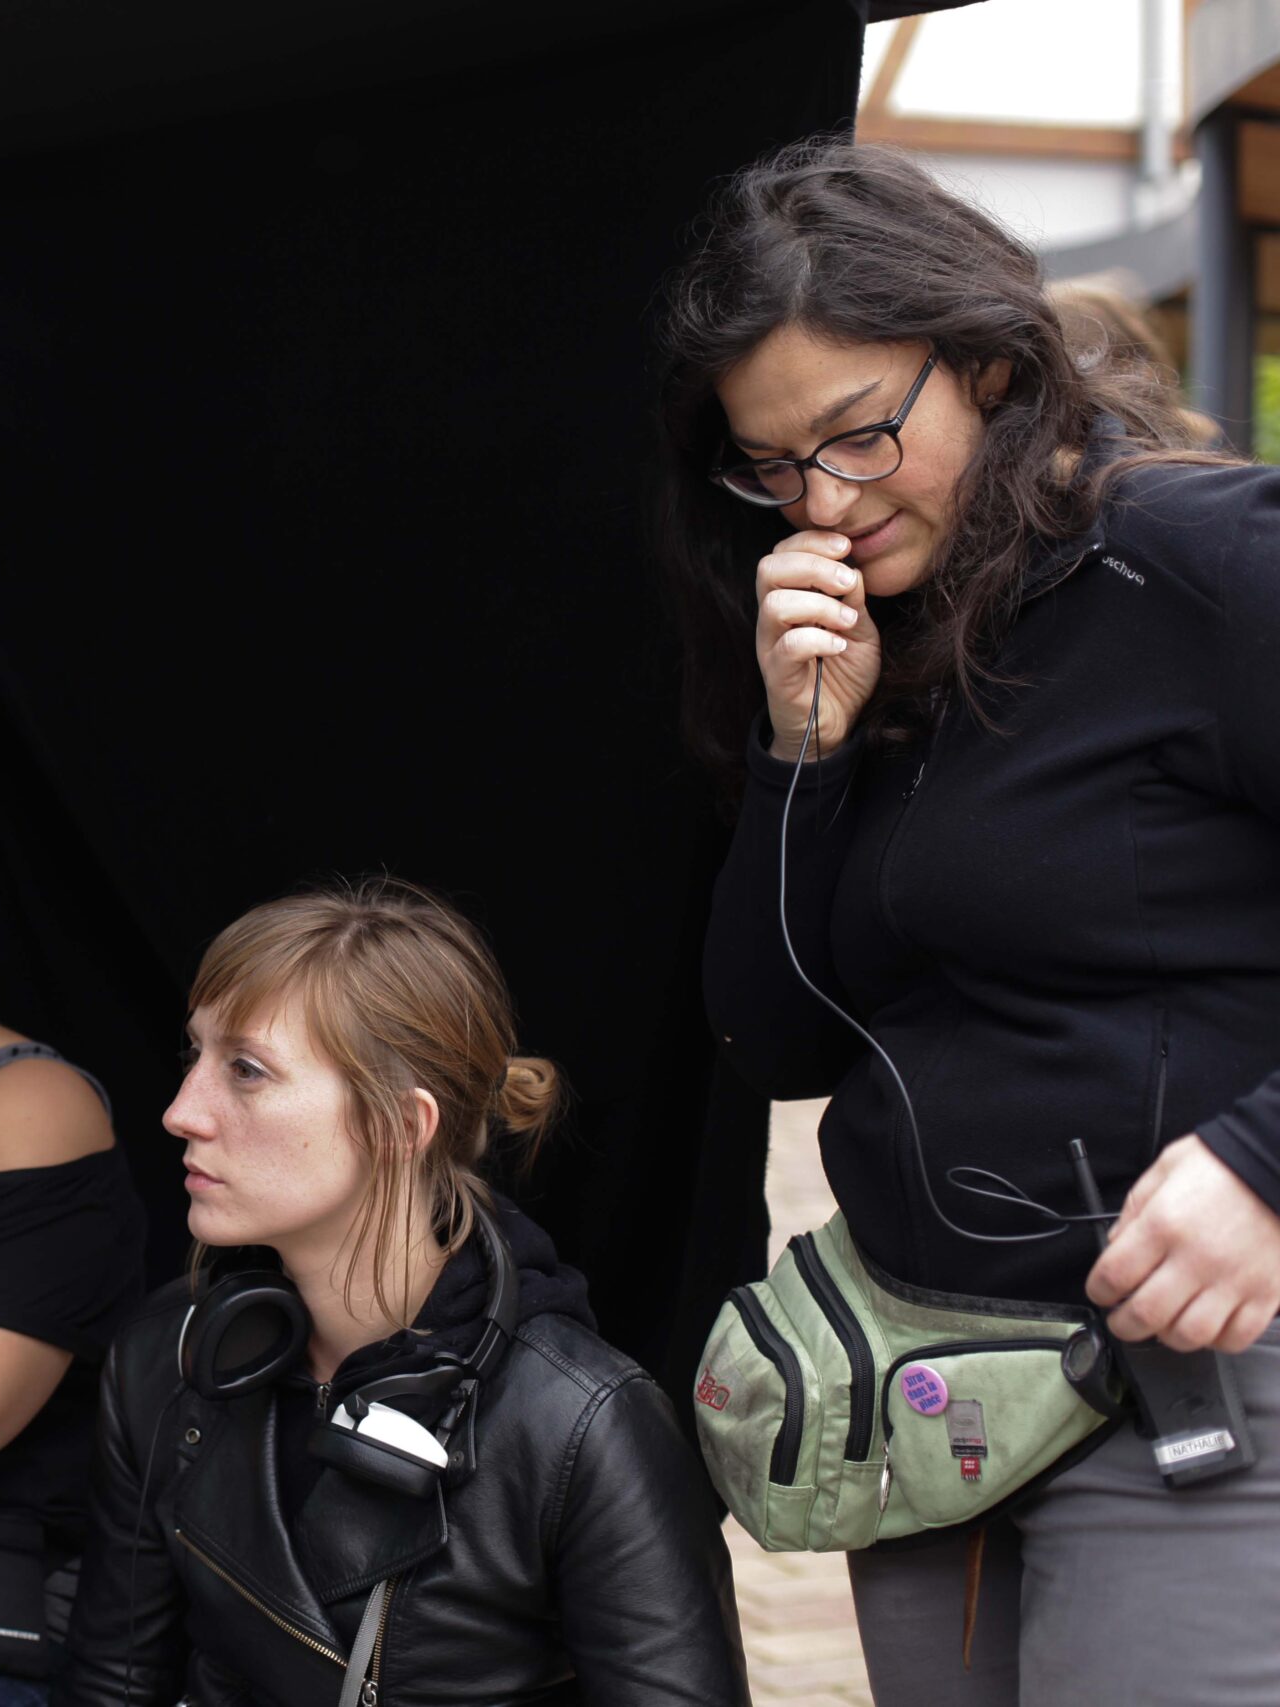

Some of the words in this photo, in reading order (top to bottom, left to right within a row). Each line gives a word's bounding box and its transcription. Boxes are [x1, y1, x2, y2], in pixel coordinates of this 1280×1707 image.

[1102, 556, 1145, 586] uechua
[918, 1394, 942, 1411] place
[1173, 1434, 1225, 1456] NATHALIE
